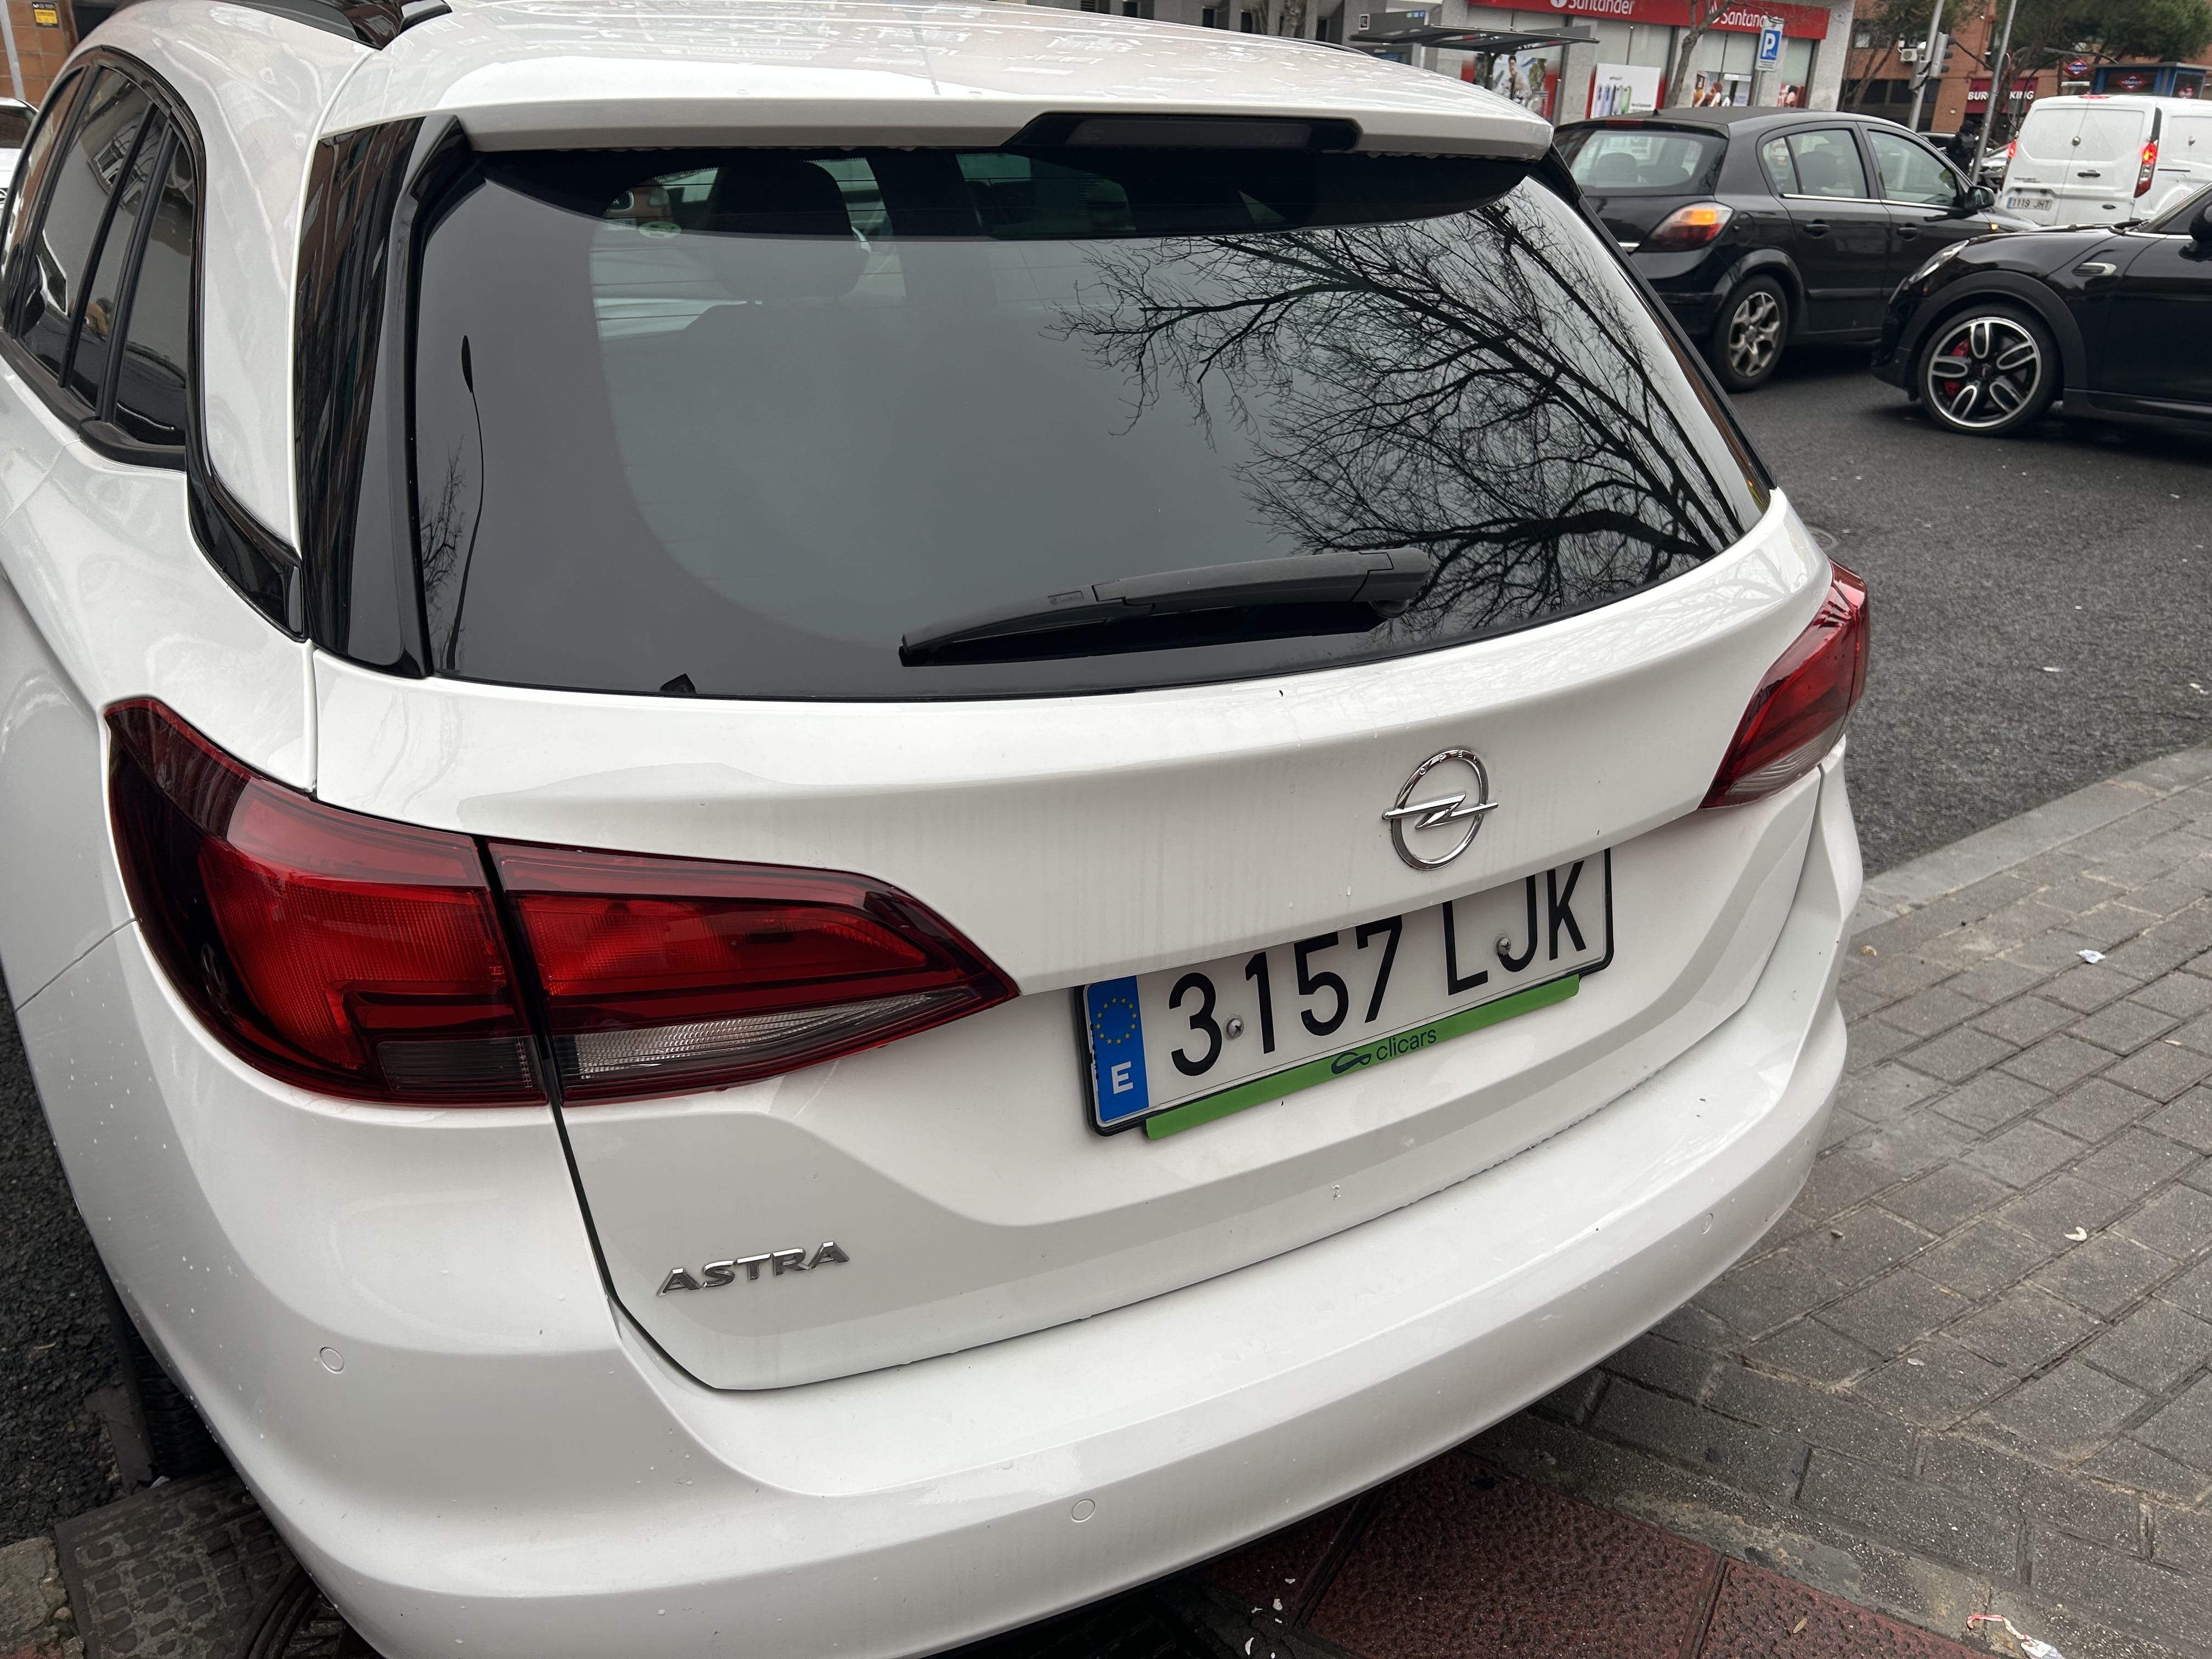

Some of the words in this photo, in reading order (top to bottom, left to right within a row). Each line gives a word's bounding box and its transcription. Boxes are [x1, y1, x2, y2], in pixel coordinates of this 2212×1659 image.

[1762, 32, 1776, 58] P
[1169, 915, 1403, 1076] 3157
[1442, 860, 1587, 996] LJK
[1376, 1029, 1436, 1060] clicars
[1110, 1061, 1133, 1094] E
[656, 1241, 850, 1297] ASTRA
